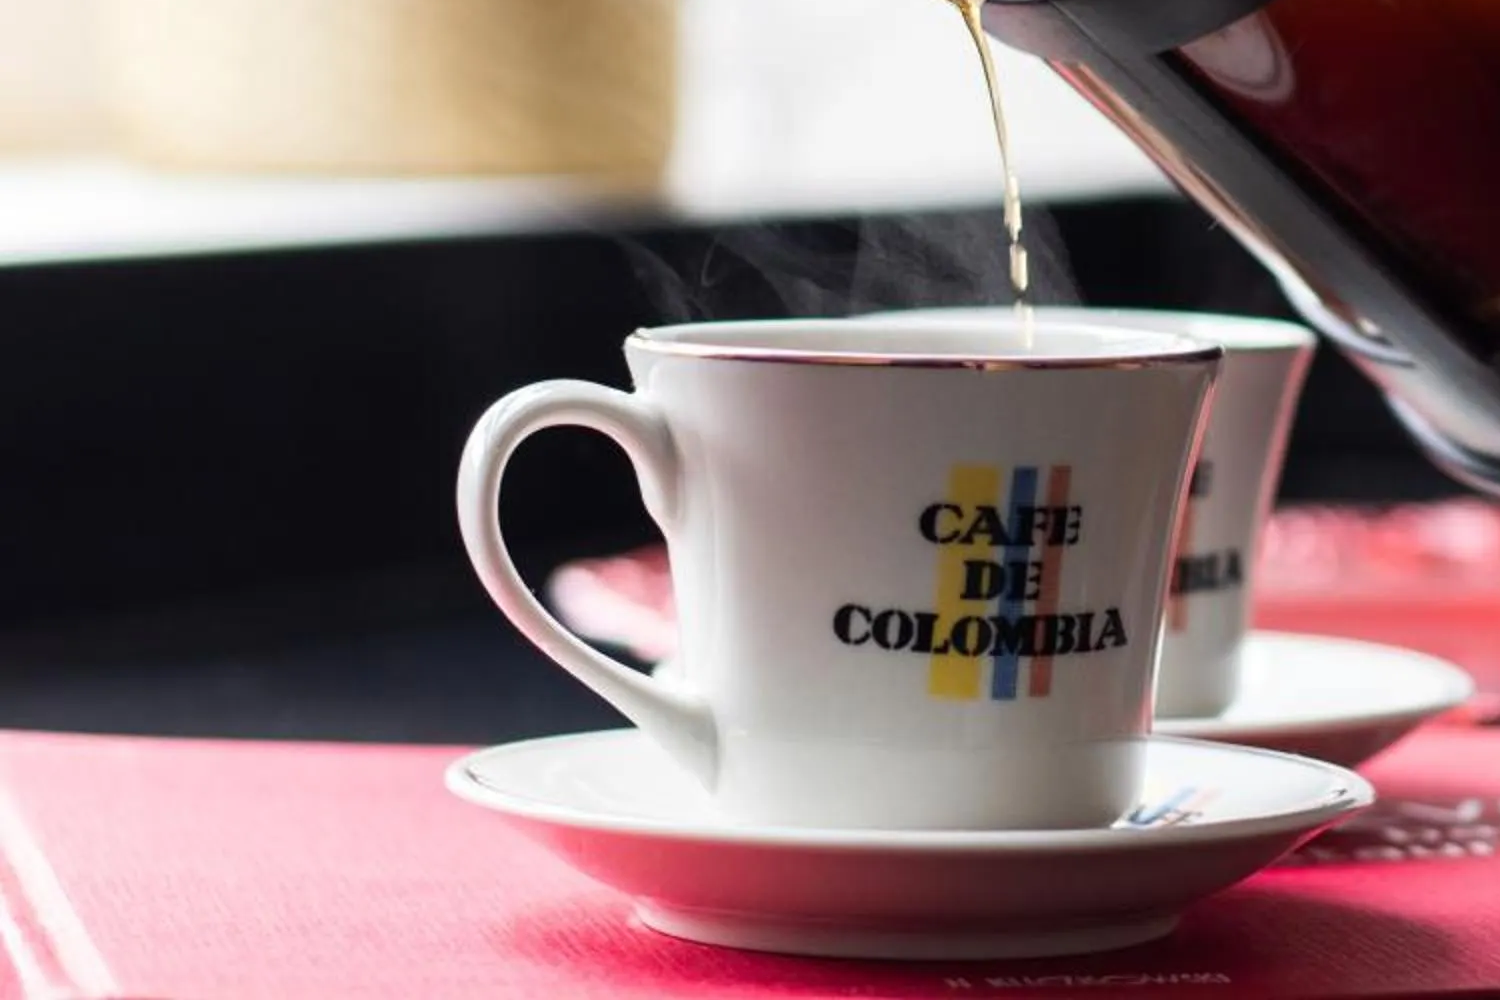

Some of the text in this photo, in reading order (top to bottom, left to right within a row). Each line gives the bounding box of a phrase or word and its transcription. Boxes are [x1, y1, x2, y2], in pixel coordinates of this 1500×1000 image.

[918, 502, 1083, 547] CAFE
[960, 559, 1044, 600] DE
[832, 603, 1129, 658] COLOMBIA
